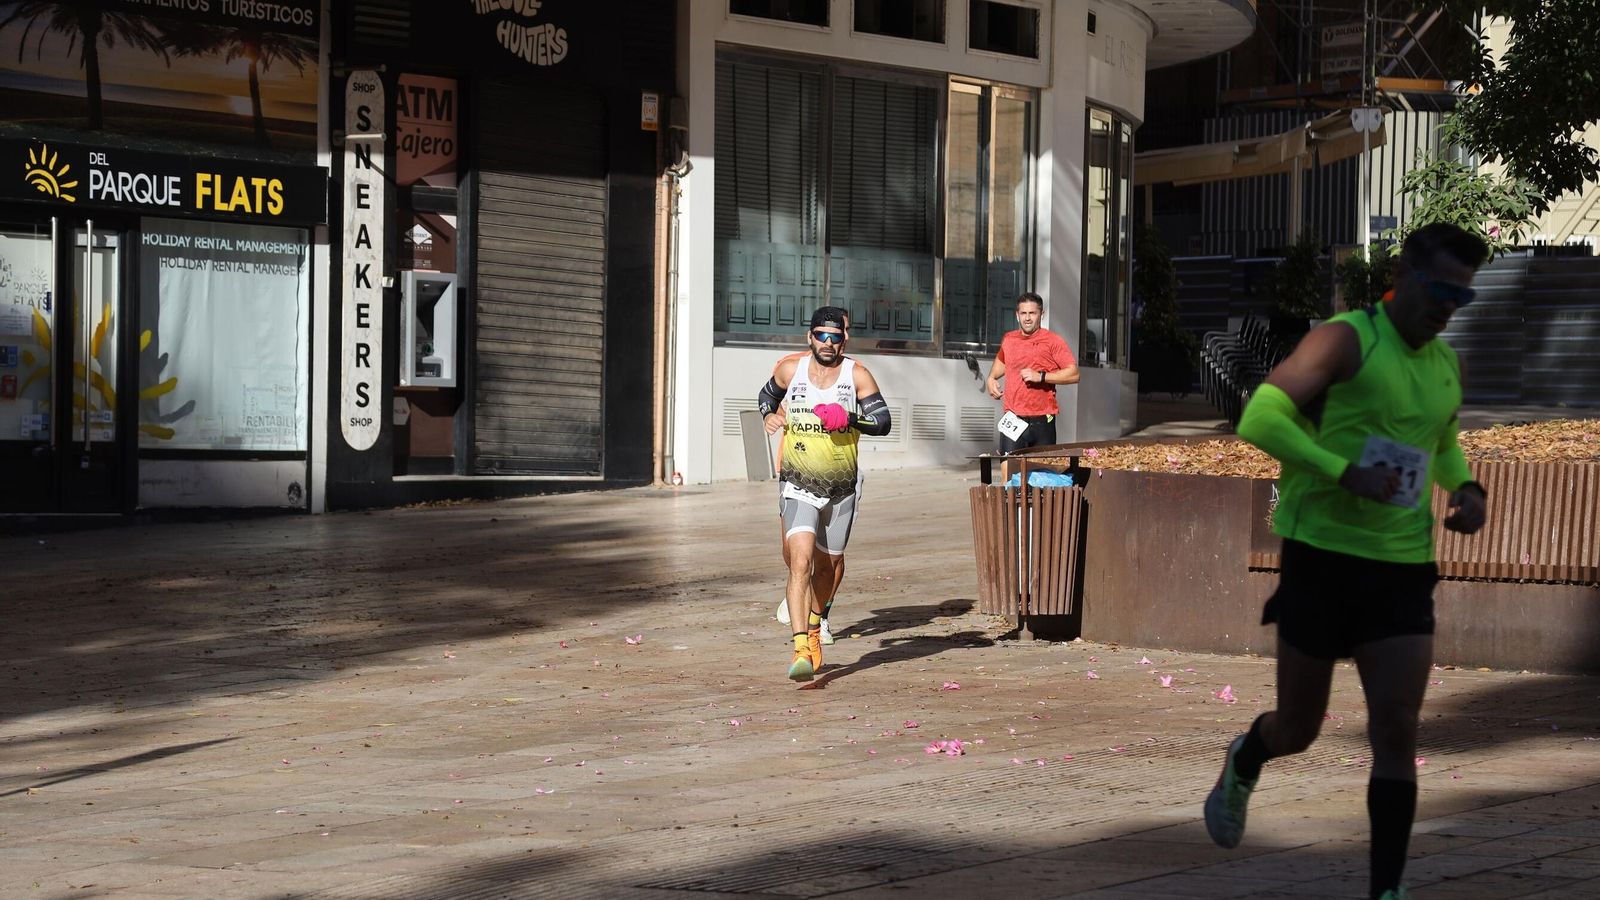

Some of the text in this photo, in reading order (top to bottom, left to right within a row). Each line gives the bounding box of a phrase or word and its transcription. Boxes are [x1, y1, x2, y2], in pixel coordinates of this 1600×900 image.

[496, 20, 569, 66] HUNTERS
[352, 81, 376, 94] SHOP
[396, 84, 452, 122] ATM
[89, 152, 110, 166] DEL
[89, 169, 284, 216] PARQUE FLATS
[142, 233, 307, 255] HOLIDAY RENTAL MANAGEMENT
[355, 105, 373, 408] SNEAKERS
[350, 417, 373, 427] SHOP
